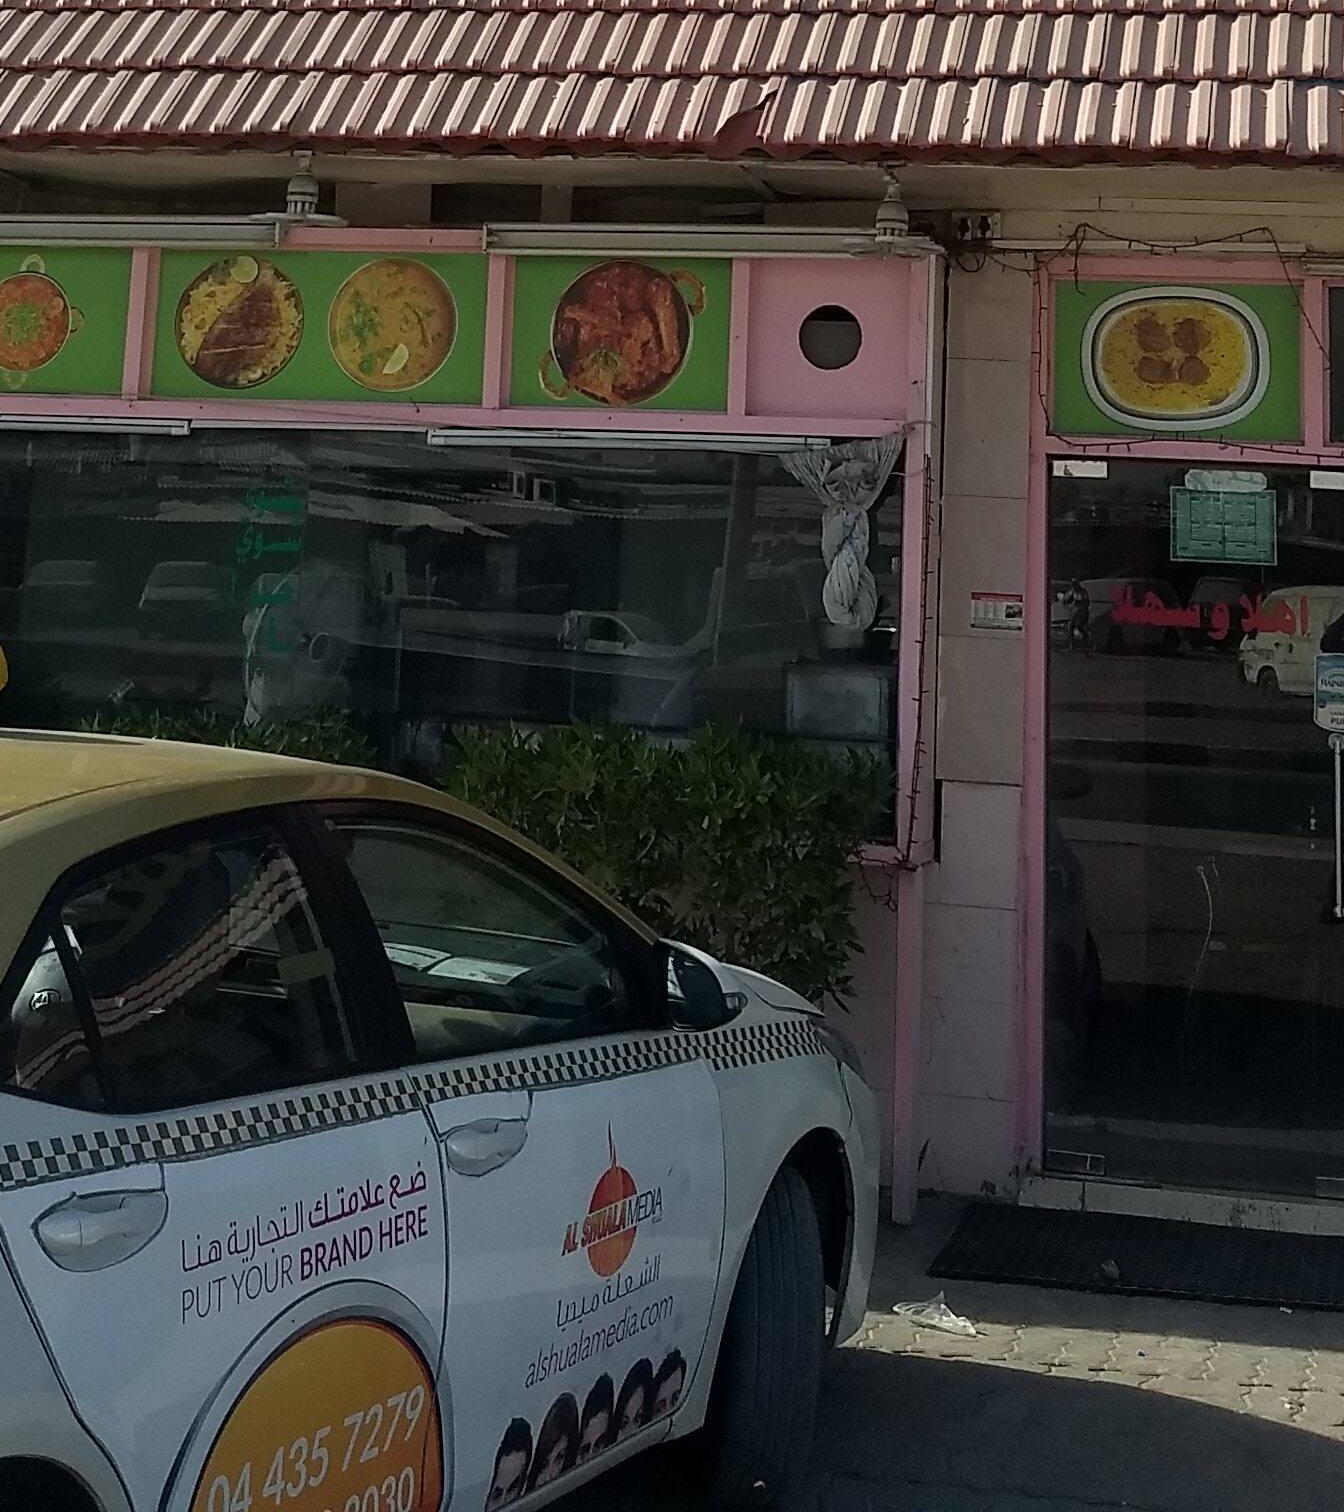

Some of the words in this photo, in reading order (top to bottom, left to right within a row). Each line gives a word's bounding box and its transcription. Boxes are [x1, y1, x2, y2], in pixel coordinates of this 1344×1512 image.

[308, 1179, 385, 1228] علامتك
[389, 1161, 427, 1209] ضع
[626, 1187, 664, 1226] MEDIA
[181, 1235, 222, 1272] هنا
[227, 1200, 304, 1265] التجارية
[182, 1277, 227, 1324] PUT
[231, 1254, 293, 1306] YOUR
[300, 1226, 373, 1281] BRAND
[379, 1205, 428, 1252] HERE
[525, 1295, 674, 1389] alshualamedia.com
[262, 1424, 332, 1506] 435
[340, 1384, 425, 1472] 7279
